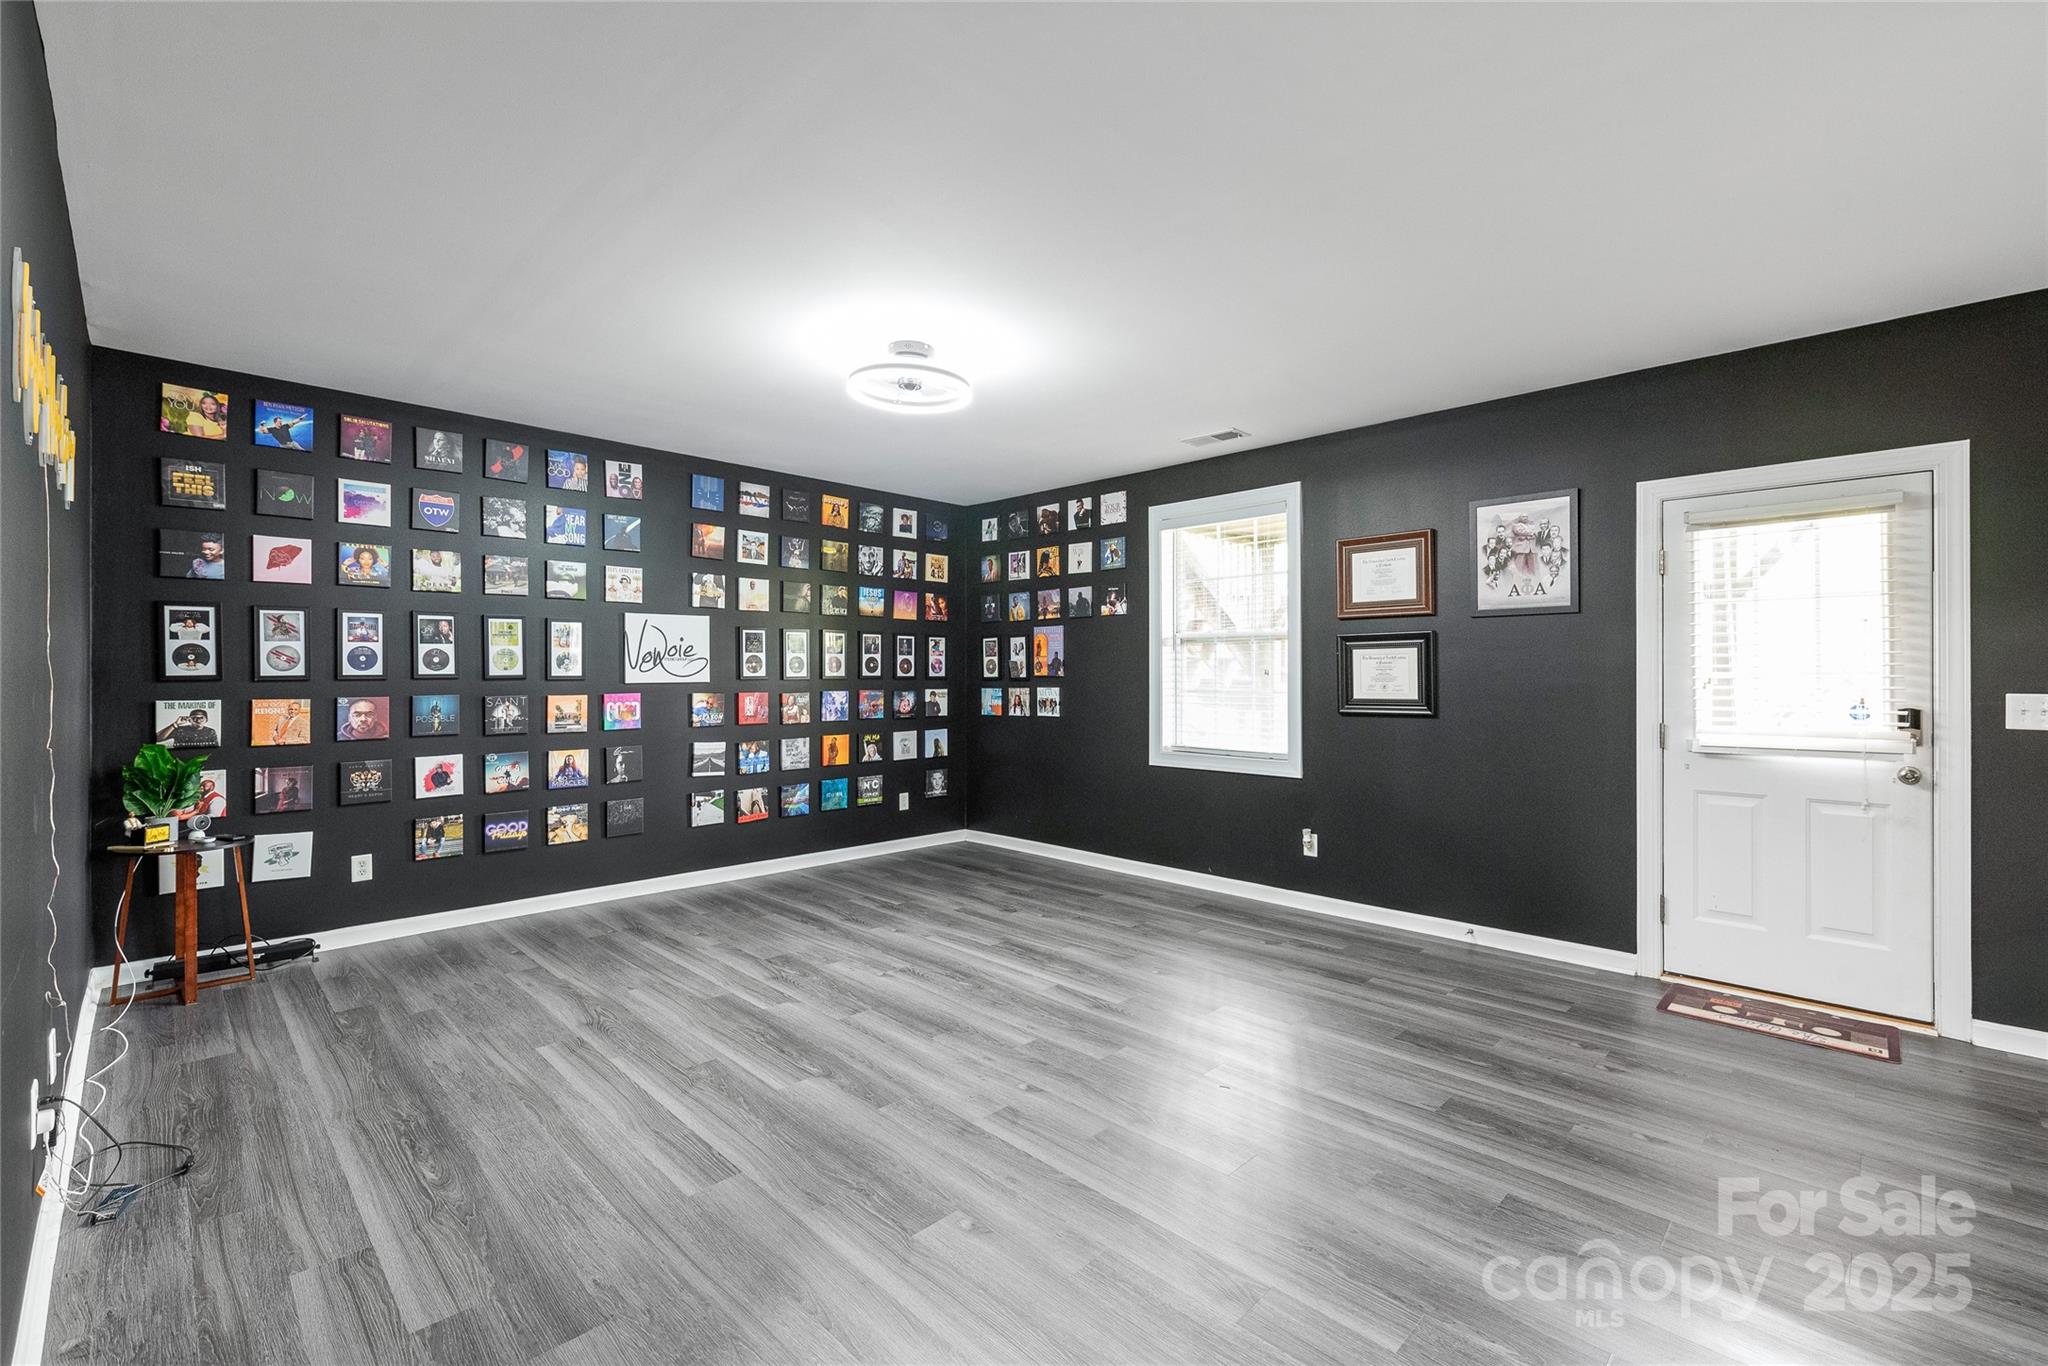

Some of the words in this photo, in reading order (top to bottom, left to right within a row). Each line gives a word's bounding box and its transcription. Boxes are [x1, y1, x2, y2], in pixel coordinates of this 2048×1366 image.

[185, 464, 202, 473] ISH
[172, 472, 214, 486] FEEL
[172, 483, 215, 497] THIS
[423, 506, 450, 517] OTW
[564, 513, 586, 527] HEAR
[564, 532, 586, 545] SONG
[863, 588, 882, 598] JESUS
[164, 702, 177, 710] THE
[178, 701, 207, 710] MAKING
[207, 701, 217, 709] OF
[415, 713, 456, 724] POSBLE
[551, 778, 587, 787] MIRACLES
[485, 820, 529, 836] GOOD
